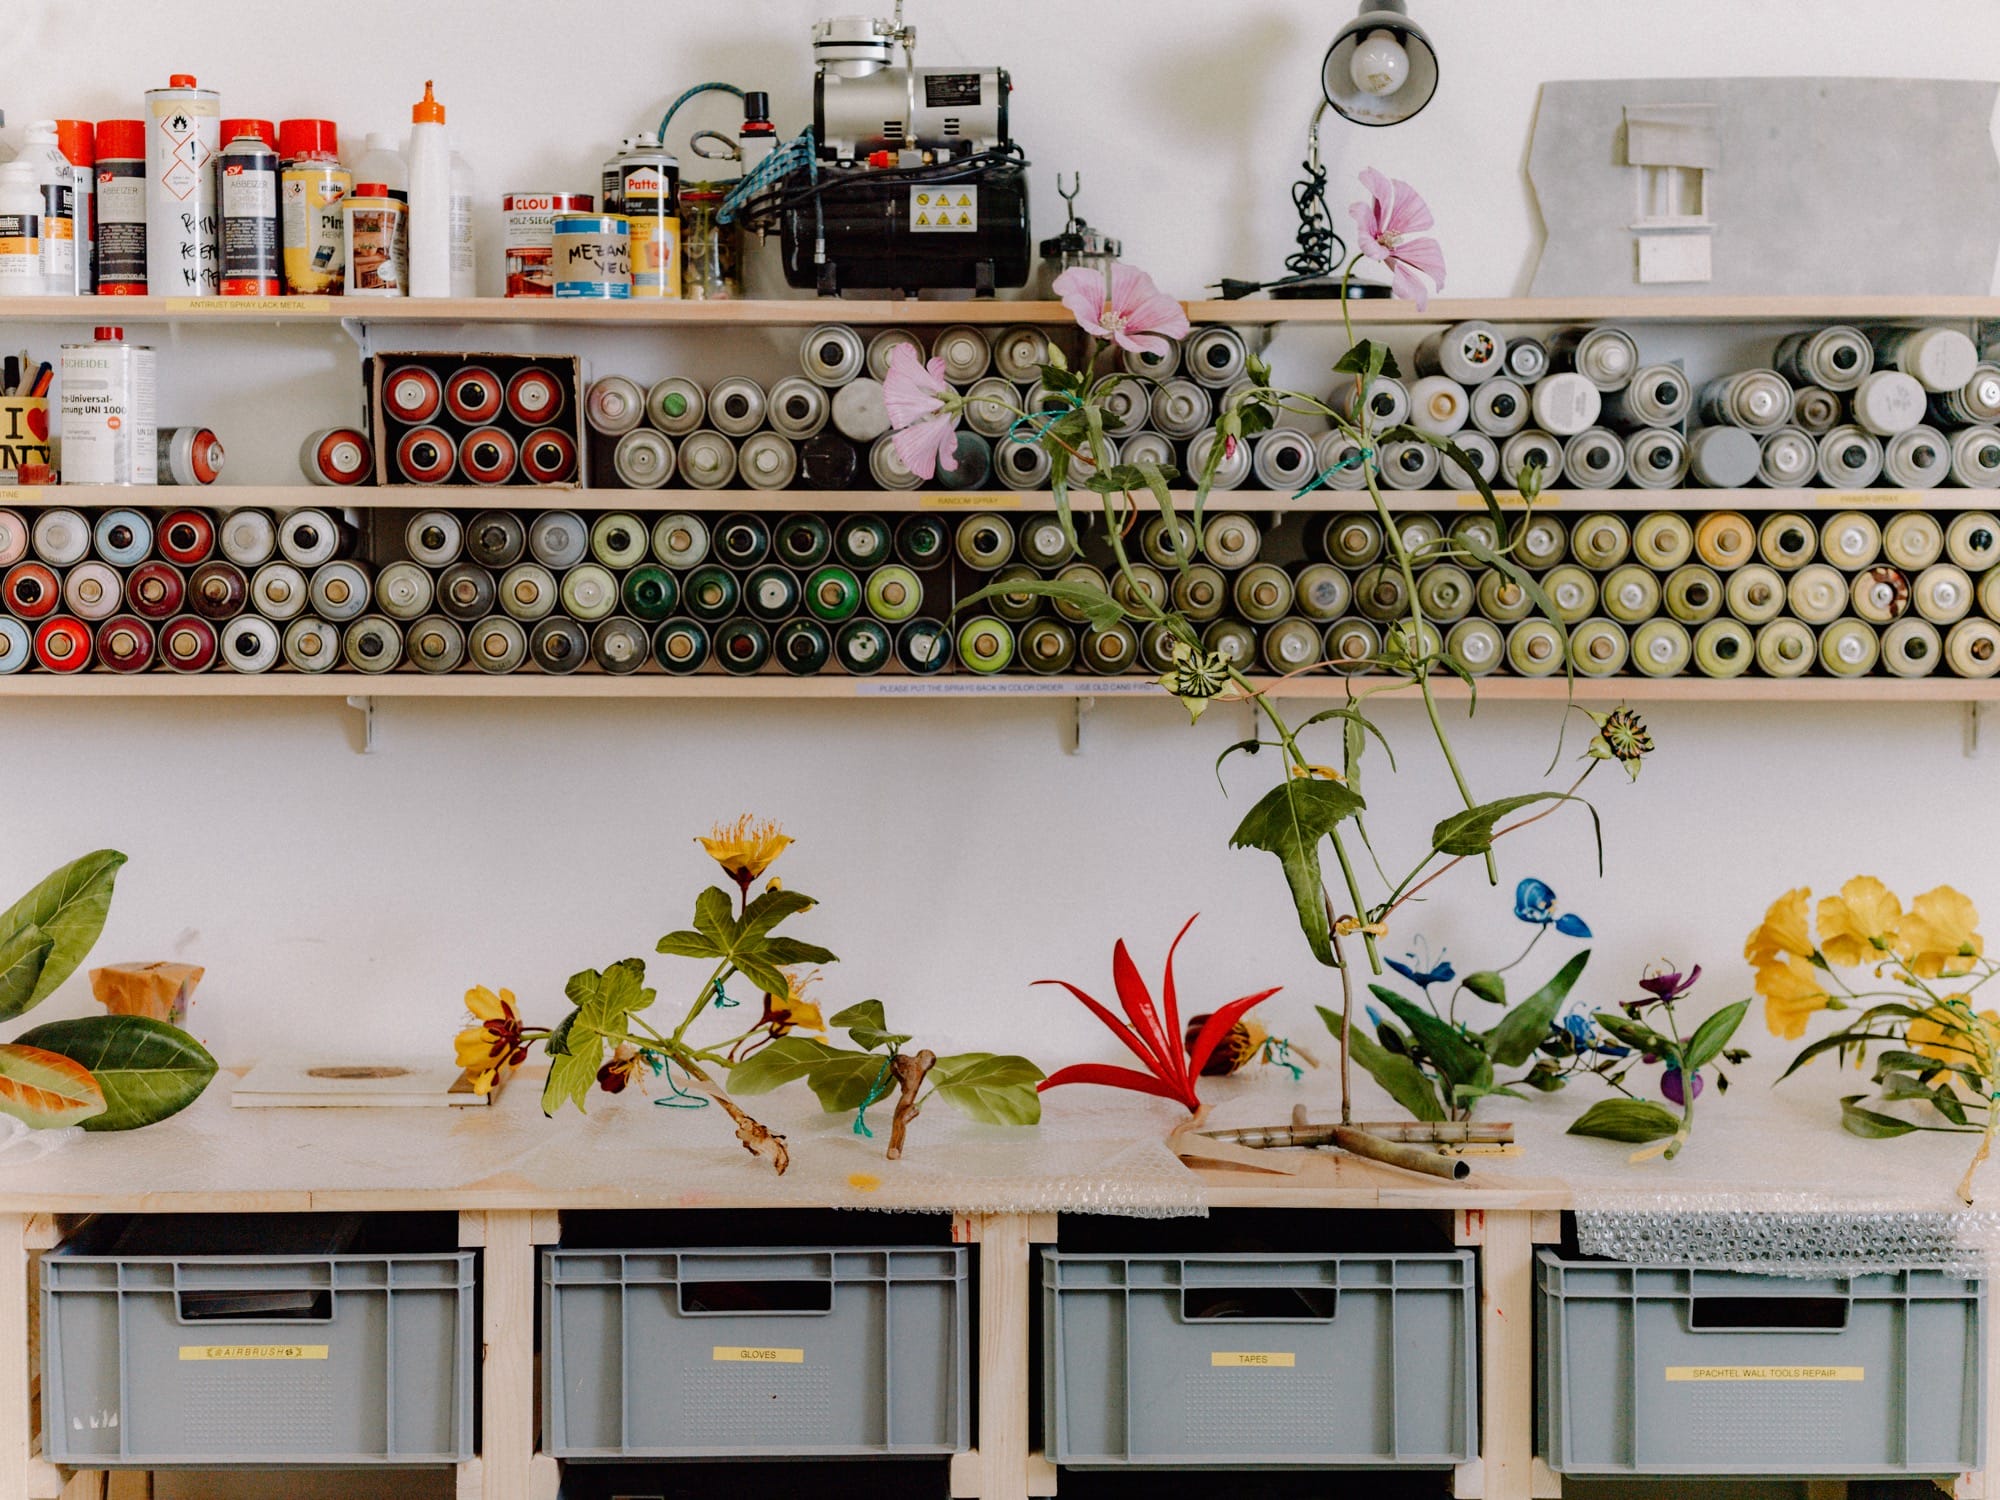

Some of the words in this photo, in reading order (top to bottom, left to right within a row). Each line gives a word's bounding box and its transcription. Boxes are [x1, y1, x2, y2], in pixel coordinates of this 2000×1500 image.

[628, 179, 664, 190] Patte
[516, 199, 549, 210] CLOU
[322, 215, 344, 229] Pin
[190, 301, 227, 309] ANTIRUST
[230, 301, 256, 309] SPRAY
[258, 301, 277, 309] LACK
[280, 301, 306, 309] METAL
[64, 360, 109, 369] SCHEIDEL
[85, 406, 101, 414] UNI
[5, 407, 24, 439] I
[0, 490, 20, 499] TINE
[938, 497, 971, 505] RANDOM
[879, 684, 907, 693] PLEASE
[911, 684, 925, 692] PUT
[928, 684, 940, 692] THE
[944, 684, 974, 692] SPRAYS
[976, 684, 996, 692] BACK
[999, 684, 1006, 692] IN
[1007, 683, 1034, 692] COLOR
[1036, 683, 1063, 692] ORDER
[1075, 682, 1090, 691] USE
[1093, 682, 1109, 691] OLD
[1110, 682, 1131, 691] CANS
[223, 1347, 286, 1357] AIRBRUSH
[740, 1350, 776, 1359] GLOVES
[1238, 1354, 1269, 1364] TAPES
[1692, 1369, 1739, 1378] SPACHTEL
[1743, 1369, 1767, 1377] WALL
[1769, 1369, 1800, 1377] TOOLS
[1803, 1369, 1837, 1377] REPAIR
